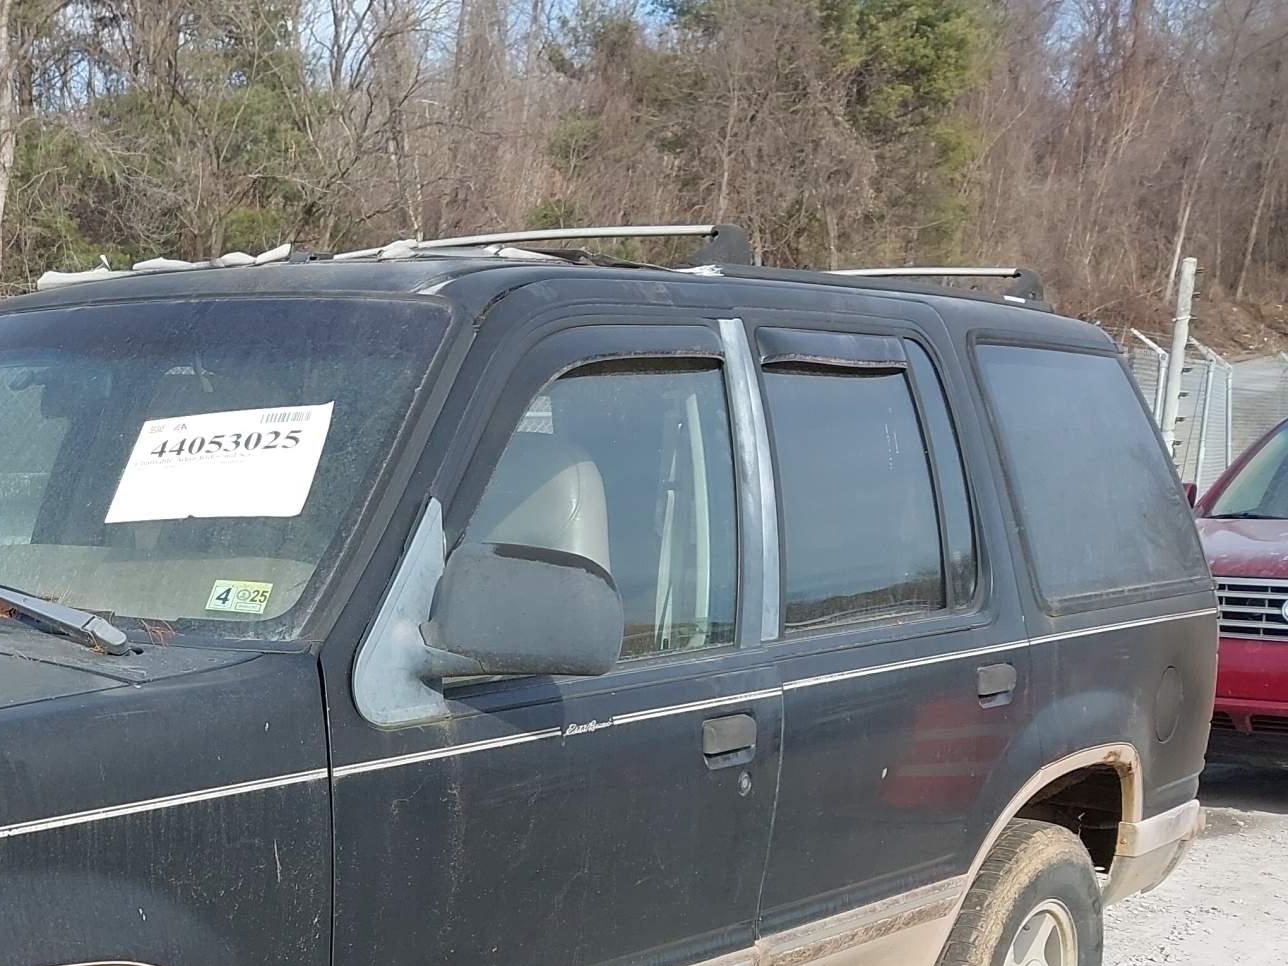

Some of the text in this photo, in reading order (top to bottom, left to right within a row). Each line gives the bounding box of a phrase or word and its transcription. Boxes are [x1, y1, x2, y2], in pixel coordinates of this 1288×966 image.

[150, 429, 303, 459] 44053025
[215, 587, 270, 605] 4 25
